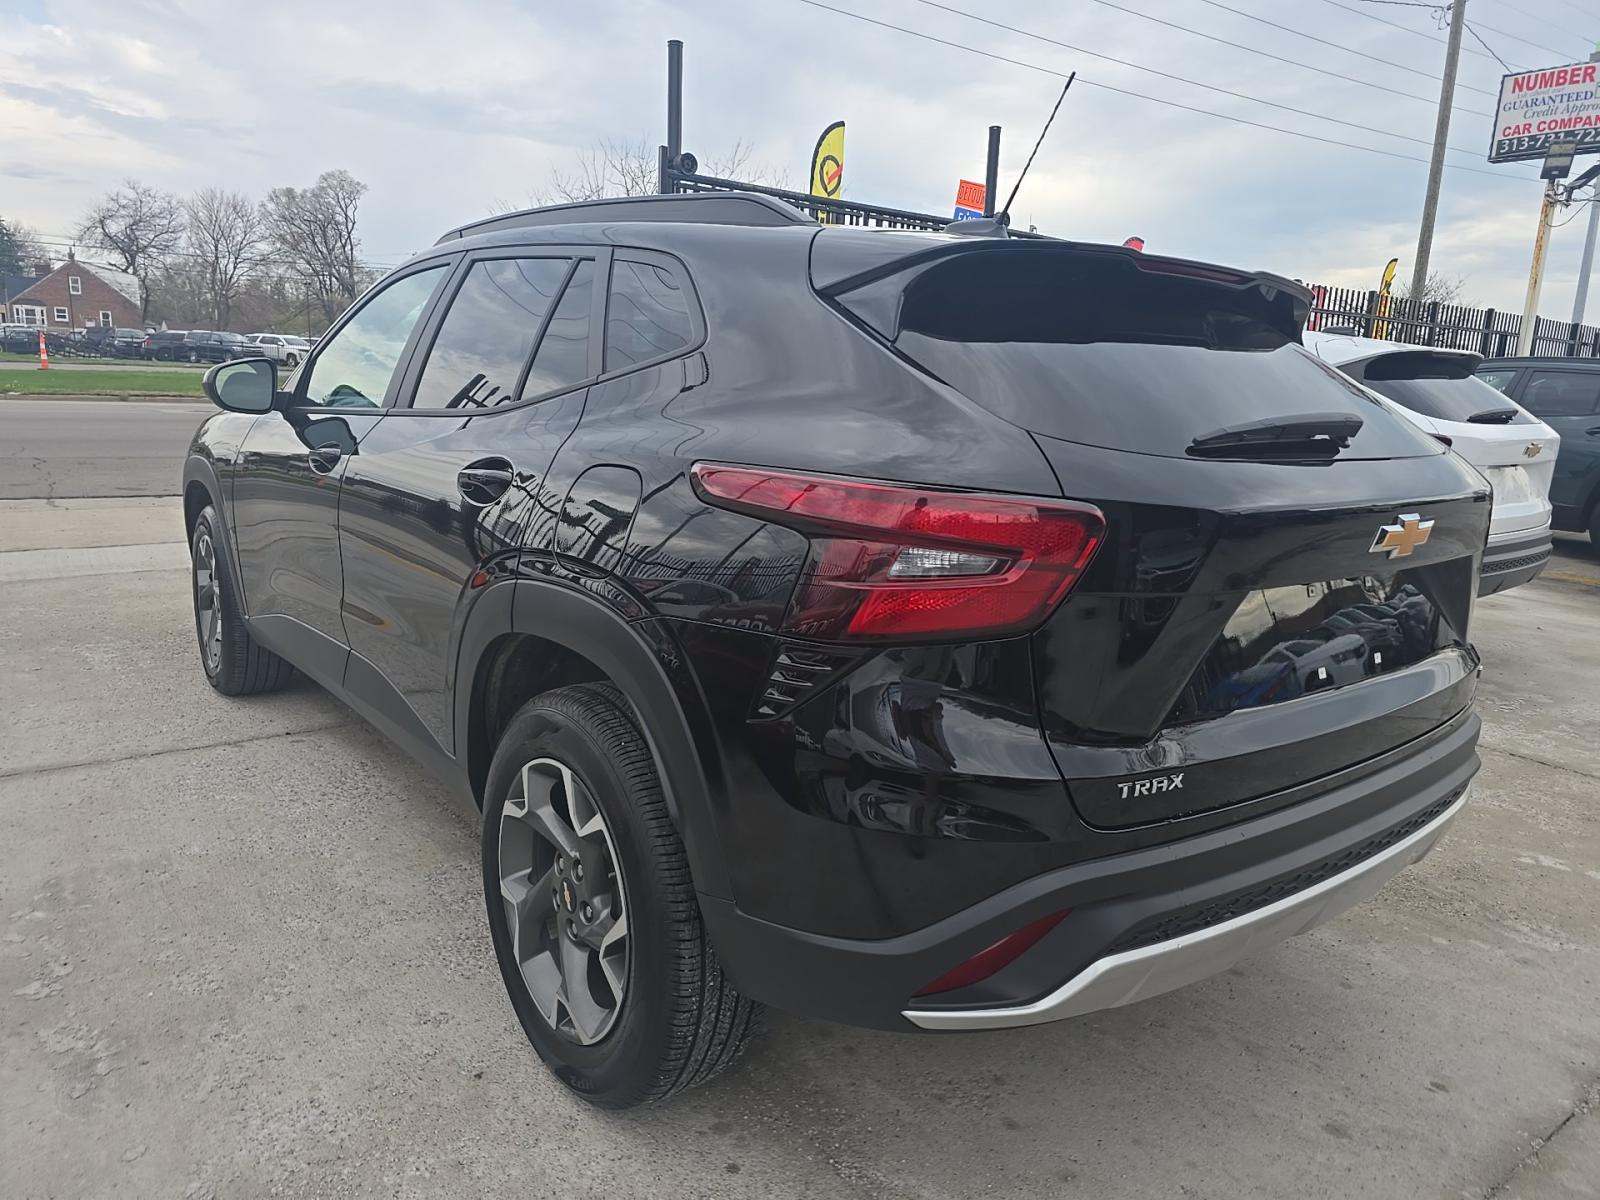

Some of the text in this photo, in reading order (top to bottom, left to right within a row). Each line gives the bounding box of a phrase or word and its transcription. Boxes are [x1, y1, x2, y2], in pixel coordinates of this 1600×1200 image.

[1512, 65, 1597, 93] NUMBER
[1503, 90, 1594, 112] GUARANTEED
[1523, 101, 1600, 119] Credit Appro
[1502, 122, 1532, 138] CAR
[1117, 773, 1184, 799] TRAX
